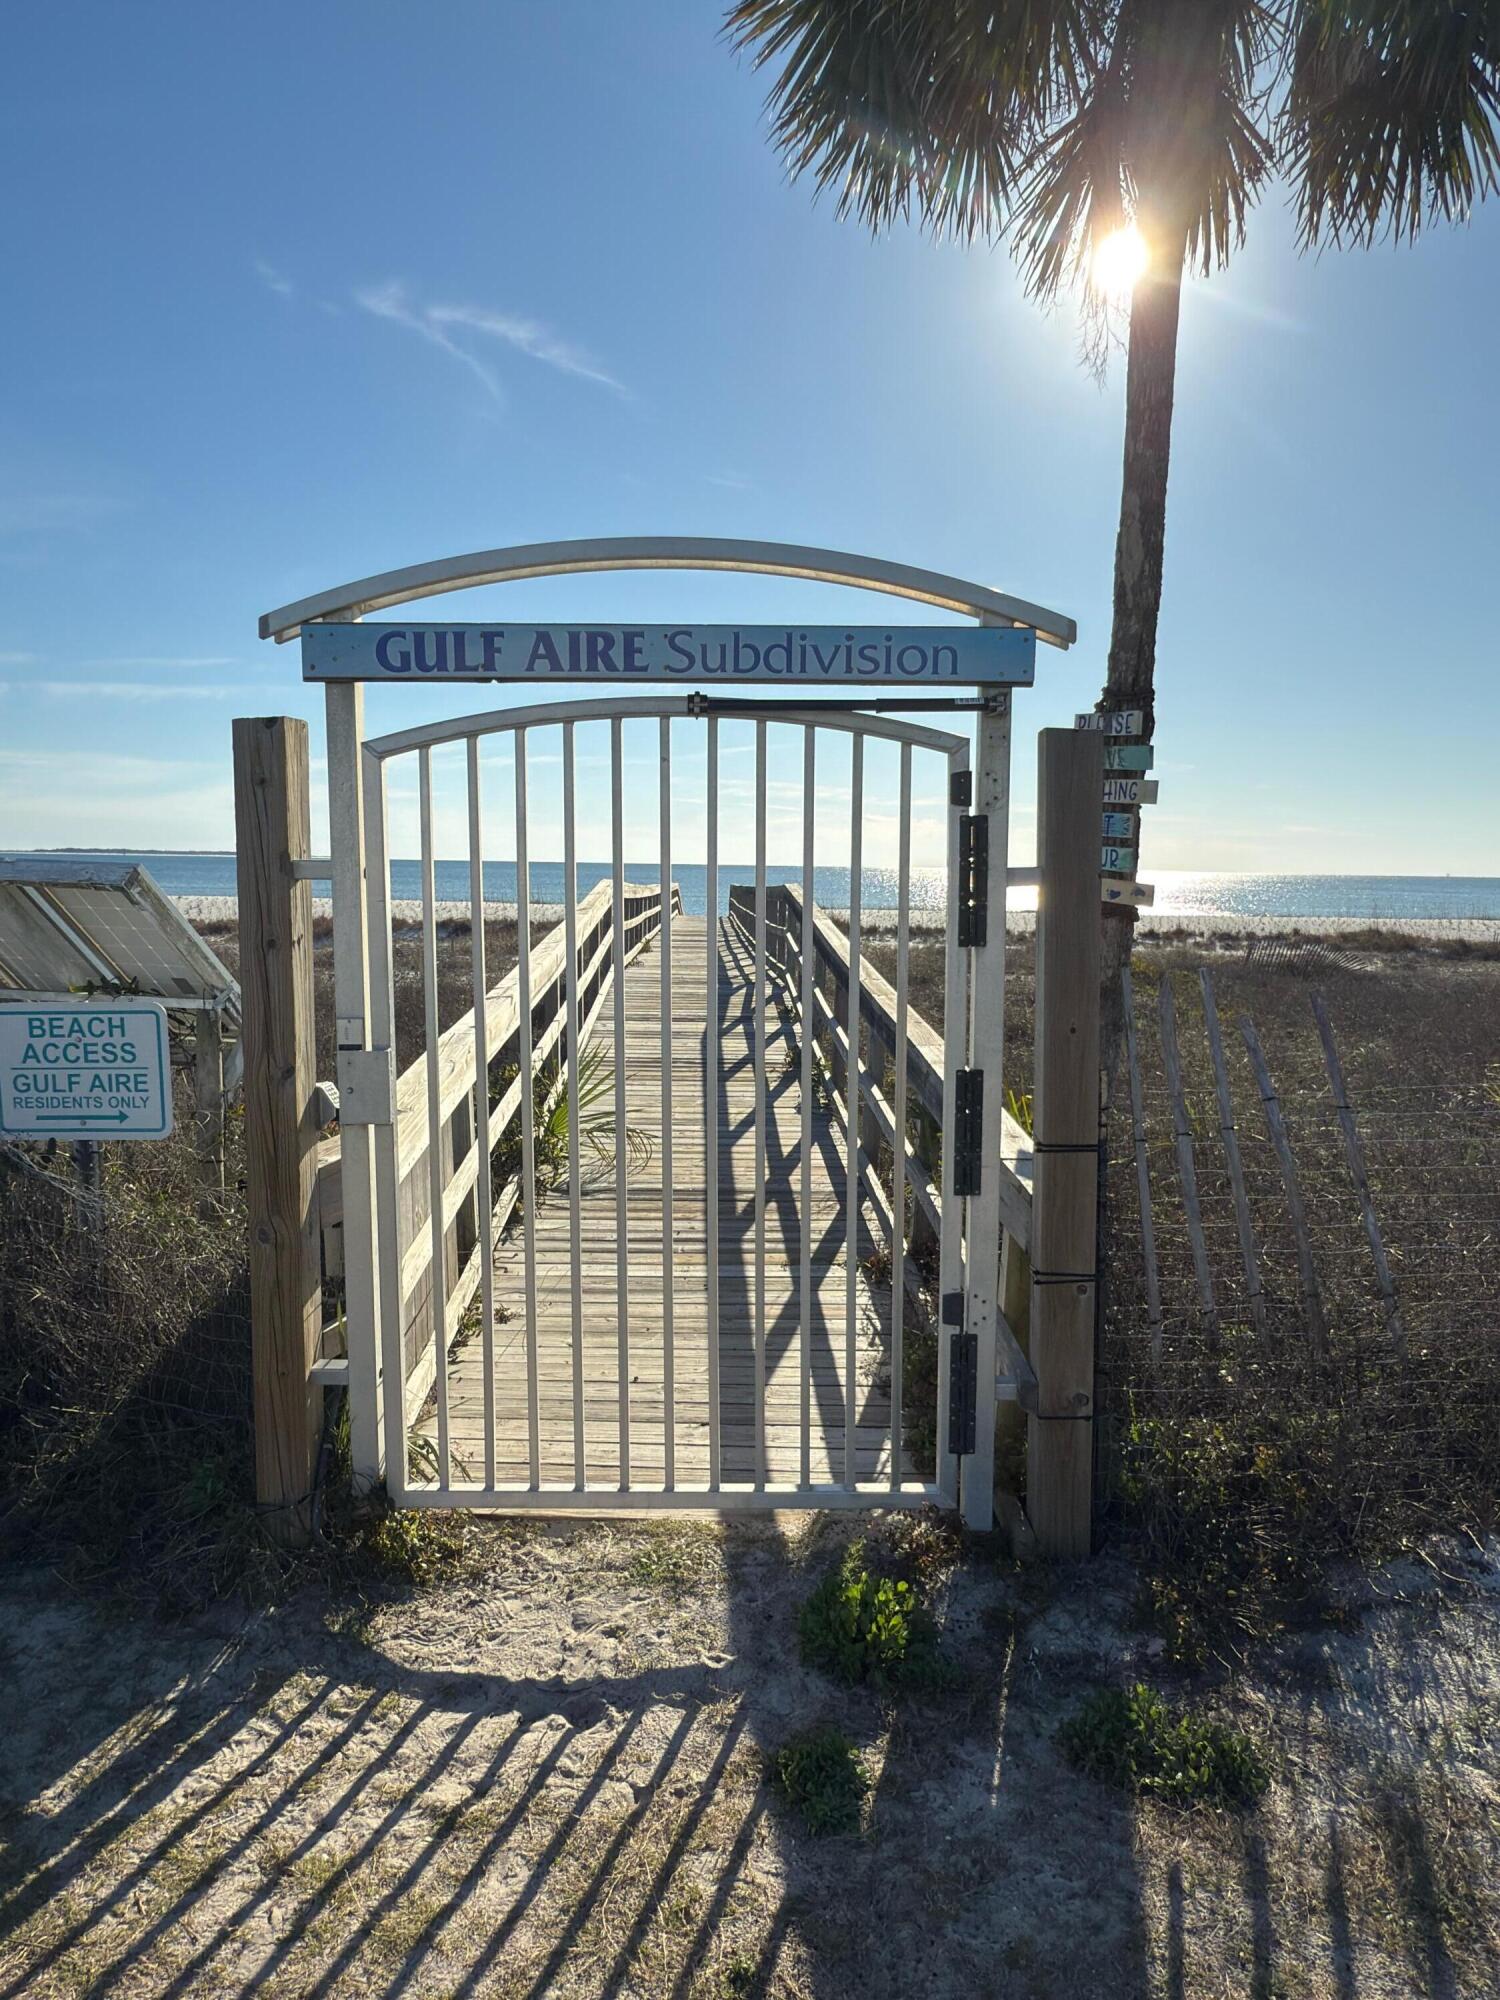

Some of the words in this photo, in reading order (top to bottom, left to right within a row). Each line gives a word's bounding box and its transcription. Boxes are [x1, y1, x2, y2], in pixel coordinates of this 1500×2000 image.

[375, 630, 505, 673] GULF
[524, 630, 650, 673] AIRE
[667, 630, 959, 675] Subdivision
[1078, 713, 1134, 734] PLESE
[27, 1017, 126, 1038] BEACH
[22, 1042, 137, 1064] ACCESS
[12, 1073, 81, 1093] GULF
[89, 1073, 149, 1093] AIRE
[13, 1096, 103, 1109] RESIDENTS
[108, 1096, 150, 1109] ONLY
